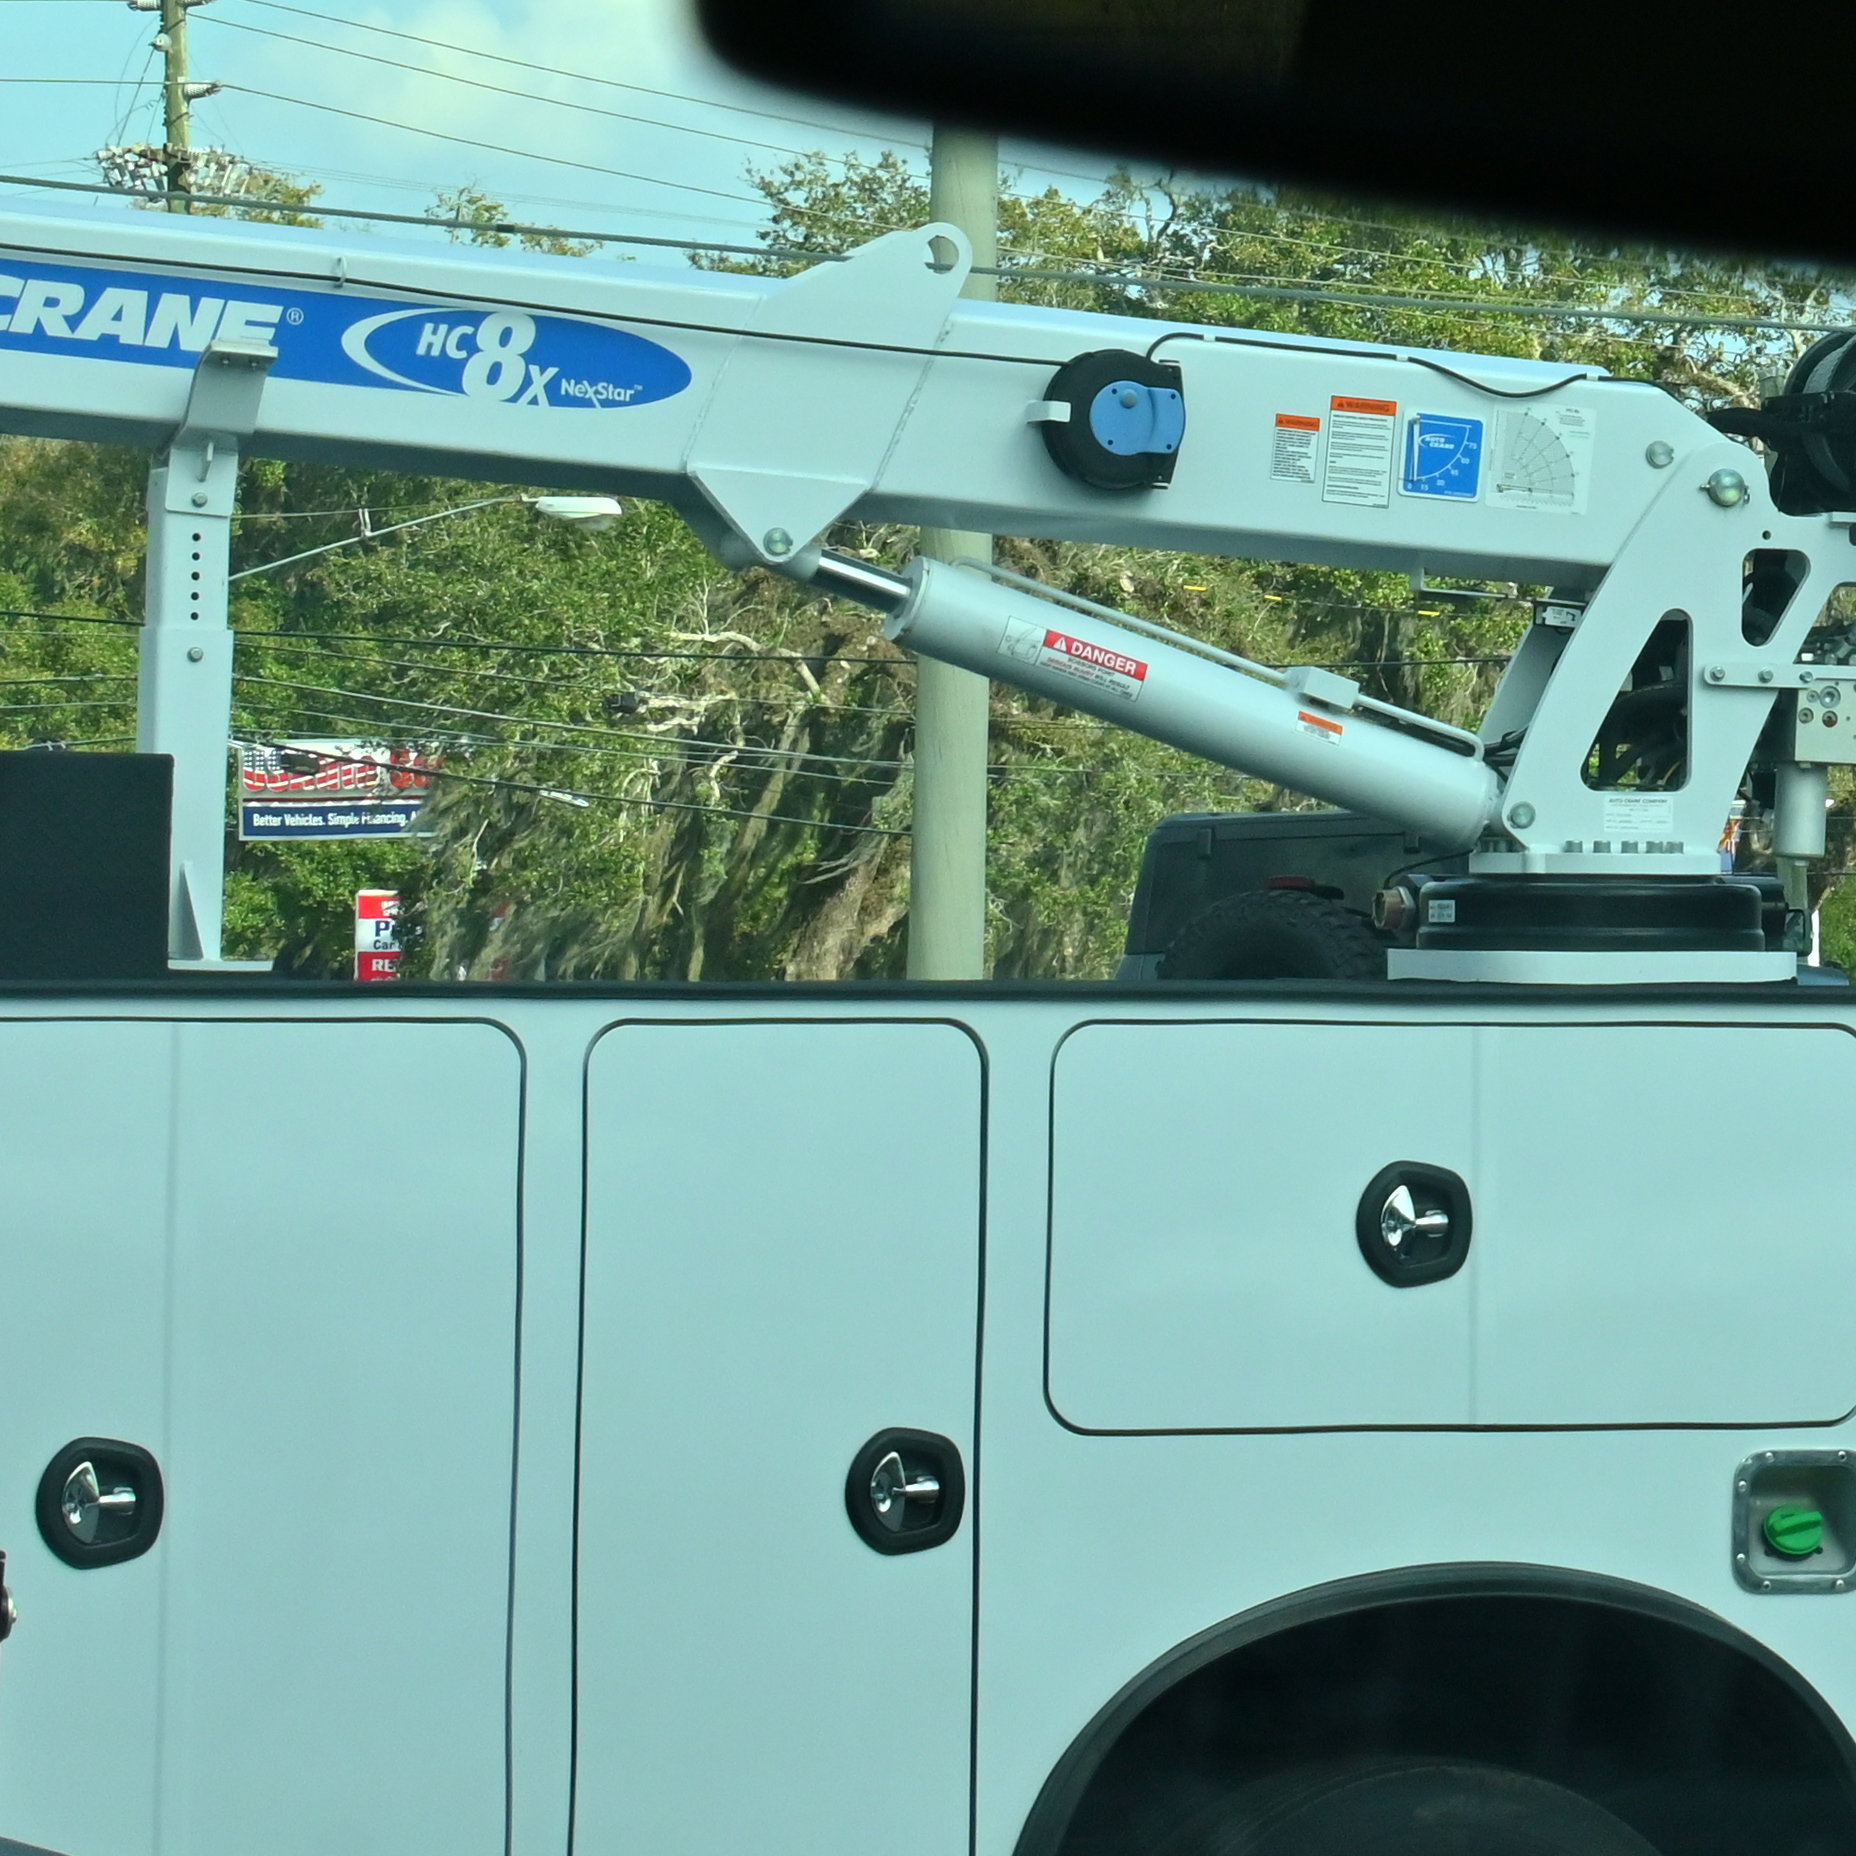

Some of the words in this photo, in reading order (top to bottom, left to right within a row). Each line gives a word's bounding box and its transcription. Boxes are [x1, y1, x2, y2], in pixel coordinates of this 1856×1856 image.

[1070, 640, 1137, 676] DANGER
[252, 812, 282, 827] Better
[284, 812, 326, 827] Vehicles.
[327, 811, 360, 829] Simple
